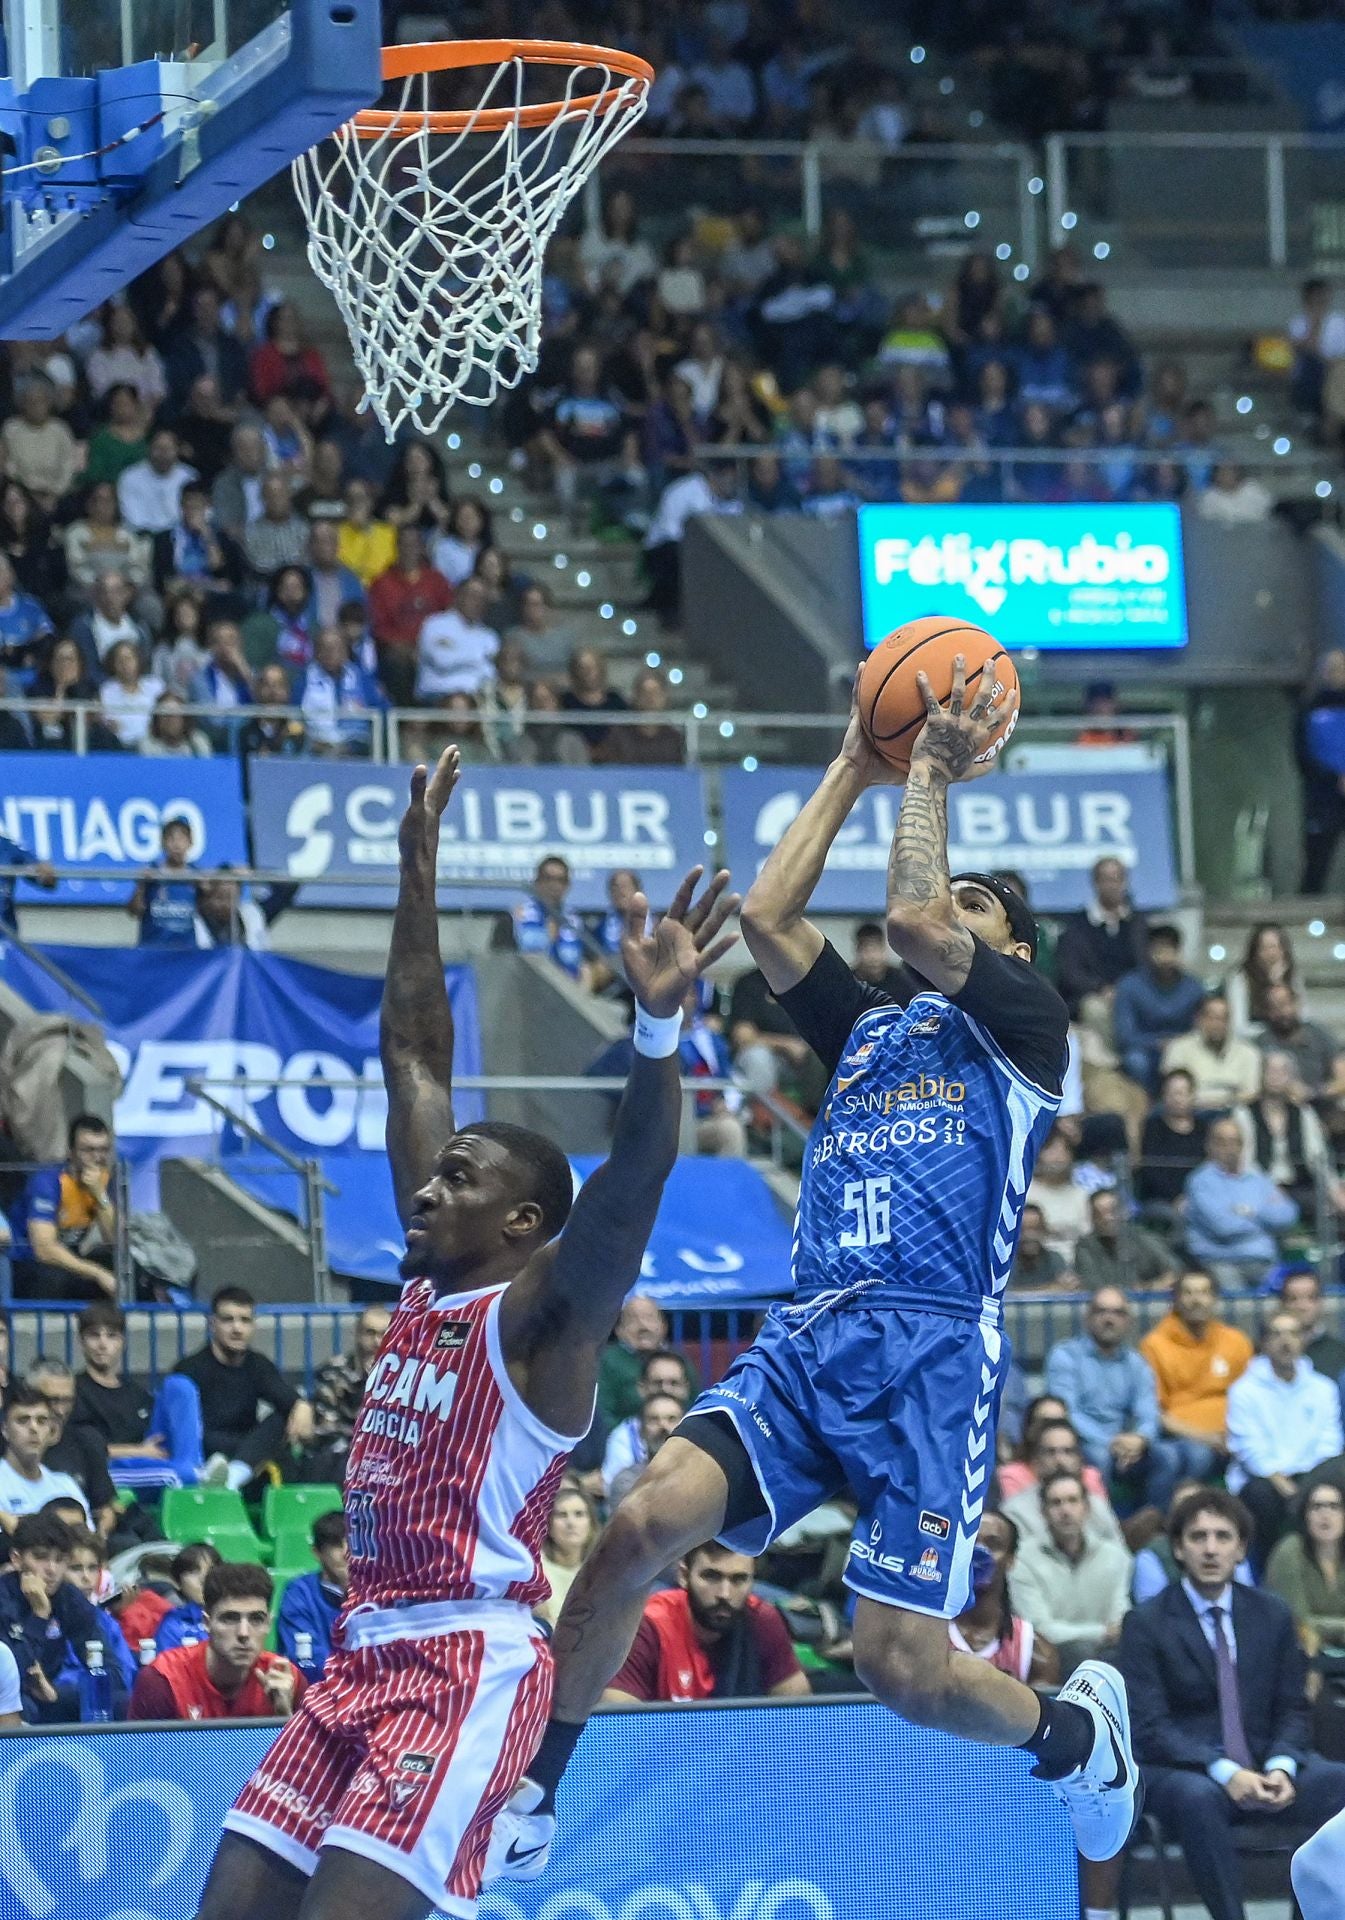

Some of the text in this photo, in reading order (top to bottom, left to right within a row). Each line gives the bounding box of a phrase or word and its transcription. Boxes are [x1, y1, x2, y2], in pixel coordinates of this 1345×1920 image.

[873, 532, 1169, 586] Félix Rubio
[346, 785, 676, 844] CIBUR
[839, 1176, 891, 1248] 56
[922, 1520, 943, 1536] acb
[402, 1759, 427, 1772] acb
